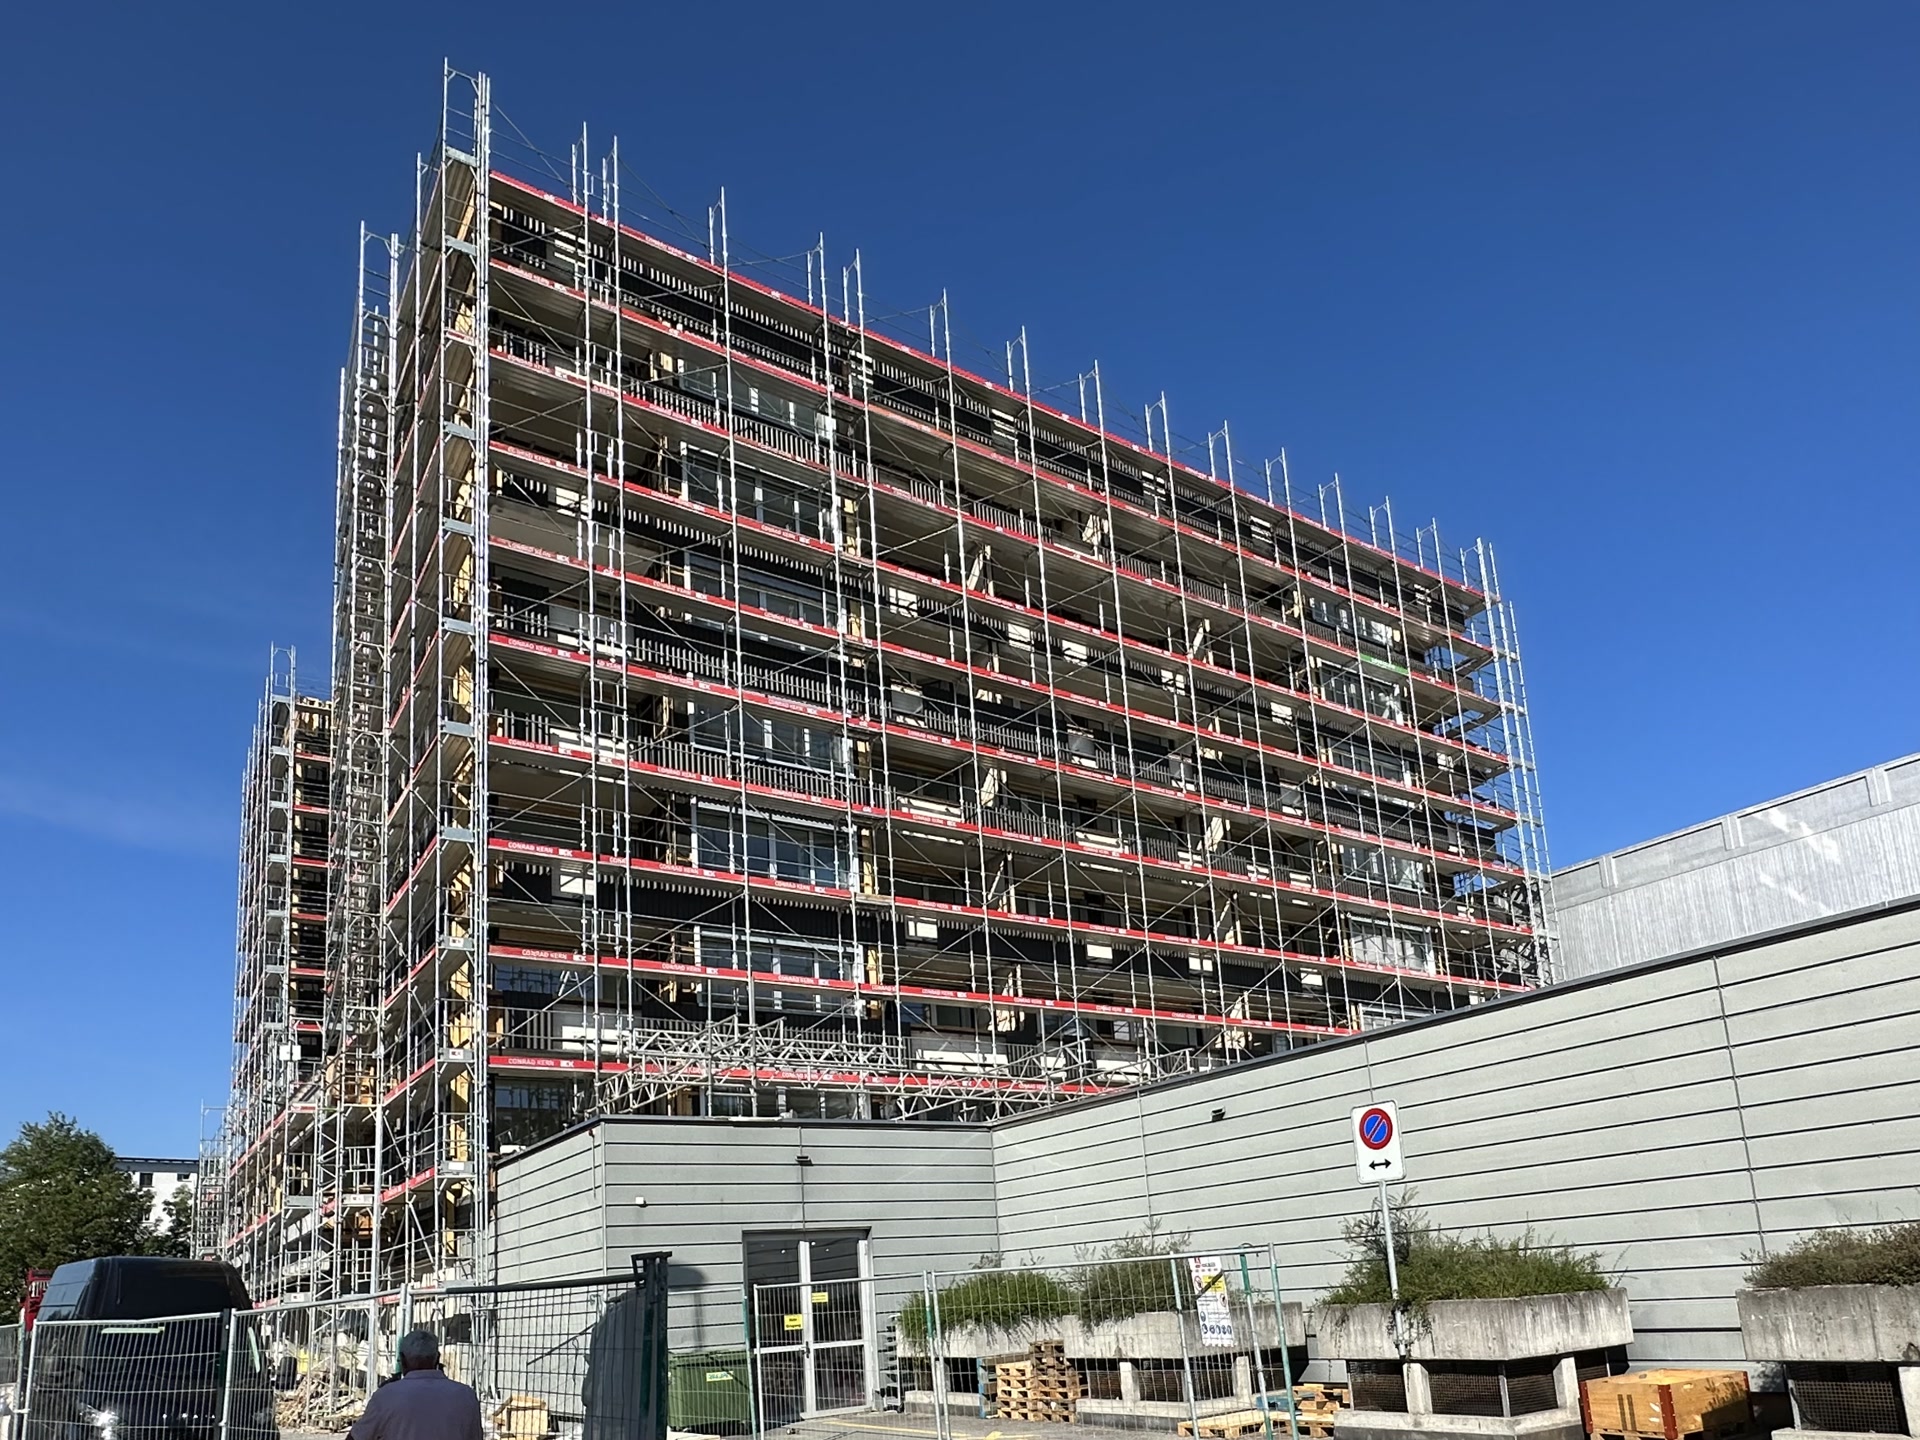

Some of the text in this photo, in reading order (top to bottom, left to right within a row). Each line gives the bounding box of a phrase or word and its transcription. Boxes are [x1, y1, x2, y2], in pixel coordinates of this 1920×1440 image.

[508, 739, 535, 749] CONRAD
[508, 842, 535, 851] CONRAD
[522, 949, 549, 959] CONRAD
[550, 952, 568, 960] KERN
[508, 1058, 536, 1066] CONRAD
